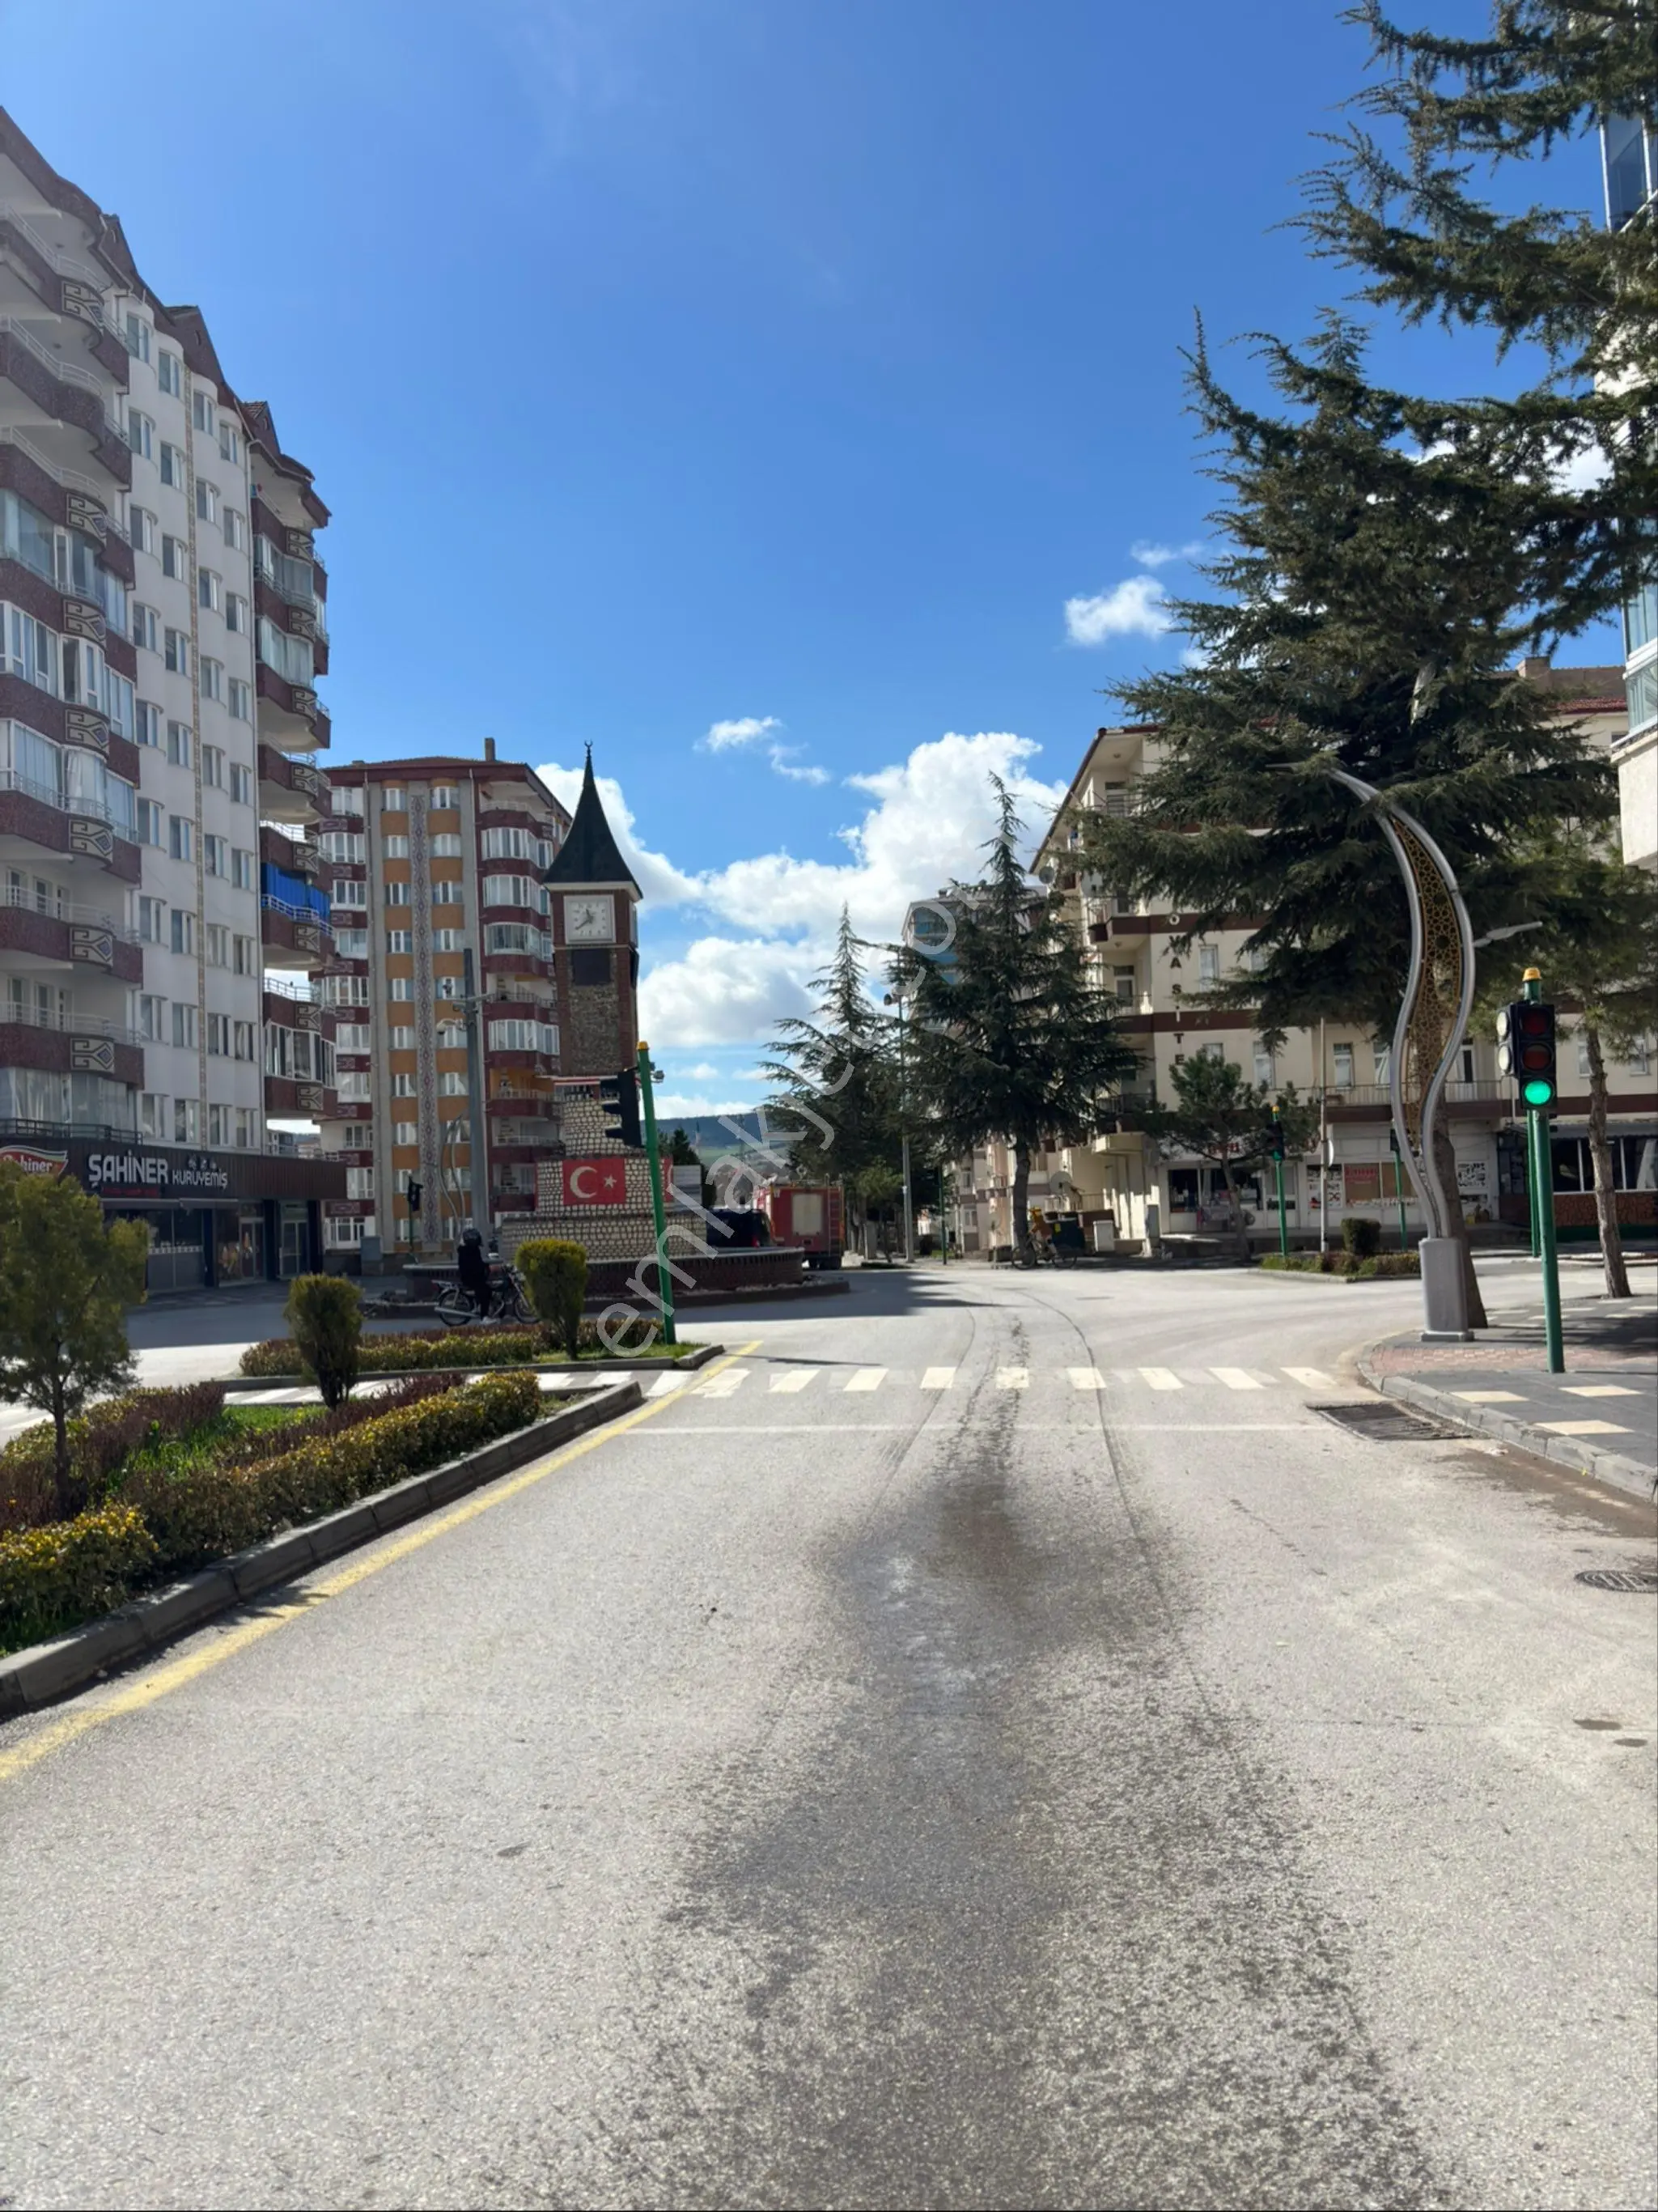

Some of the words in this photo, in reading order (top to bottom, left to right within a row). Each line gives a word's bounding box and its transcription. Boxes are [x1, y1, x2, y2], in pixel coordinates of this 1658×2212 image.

[2, 1154, 53, 1173] hiner
[87, 1149, 169, 1188] ŞAHİNER
[172, 1168, 228, 1190] KURUYEMİŞ
